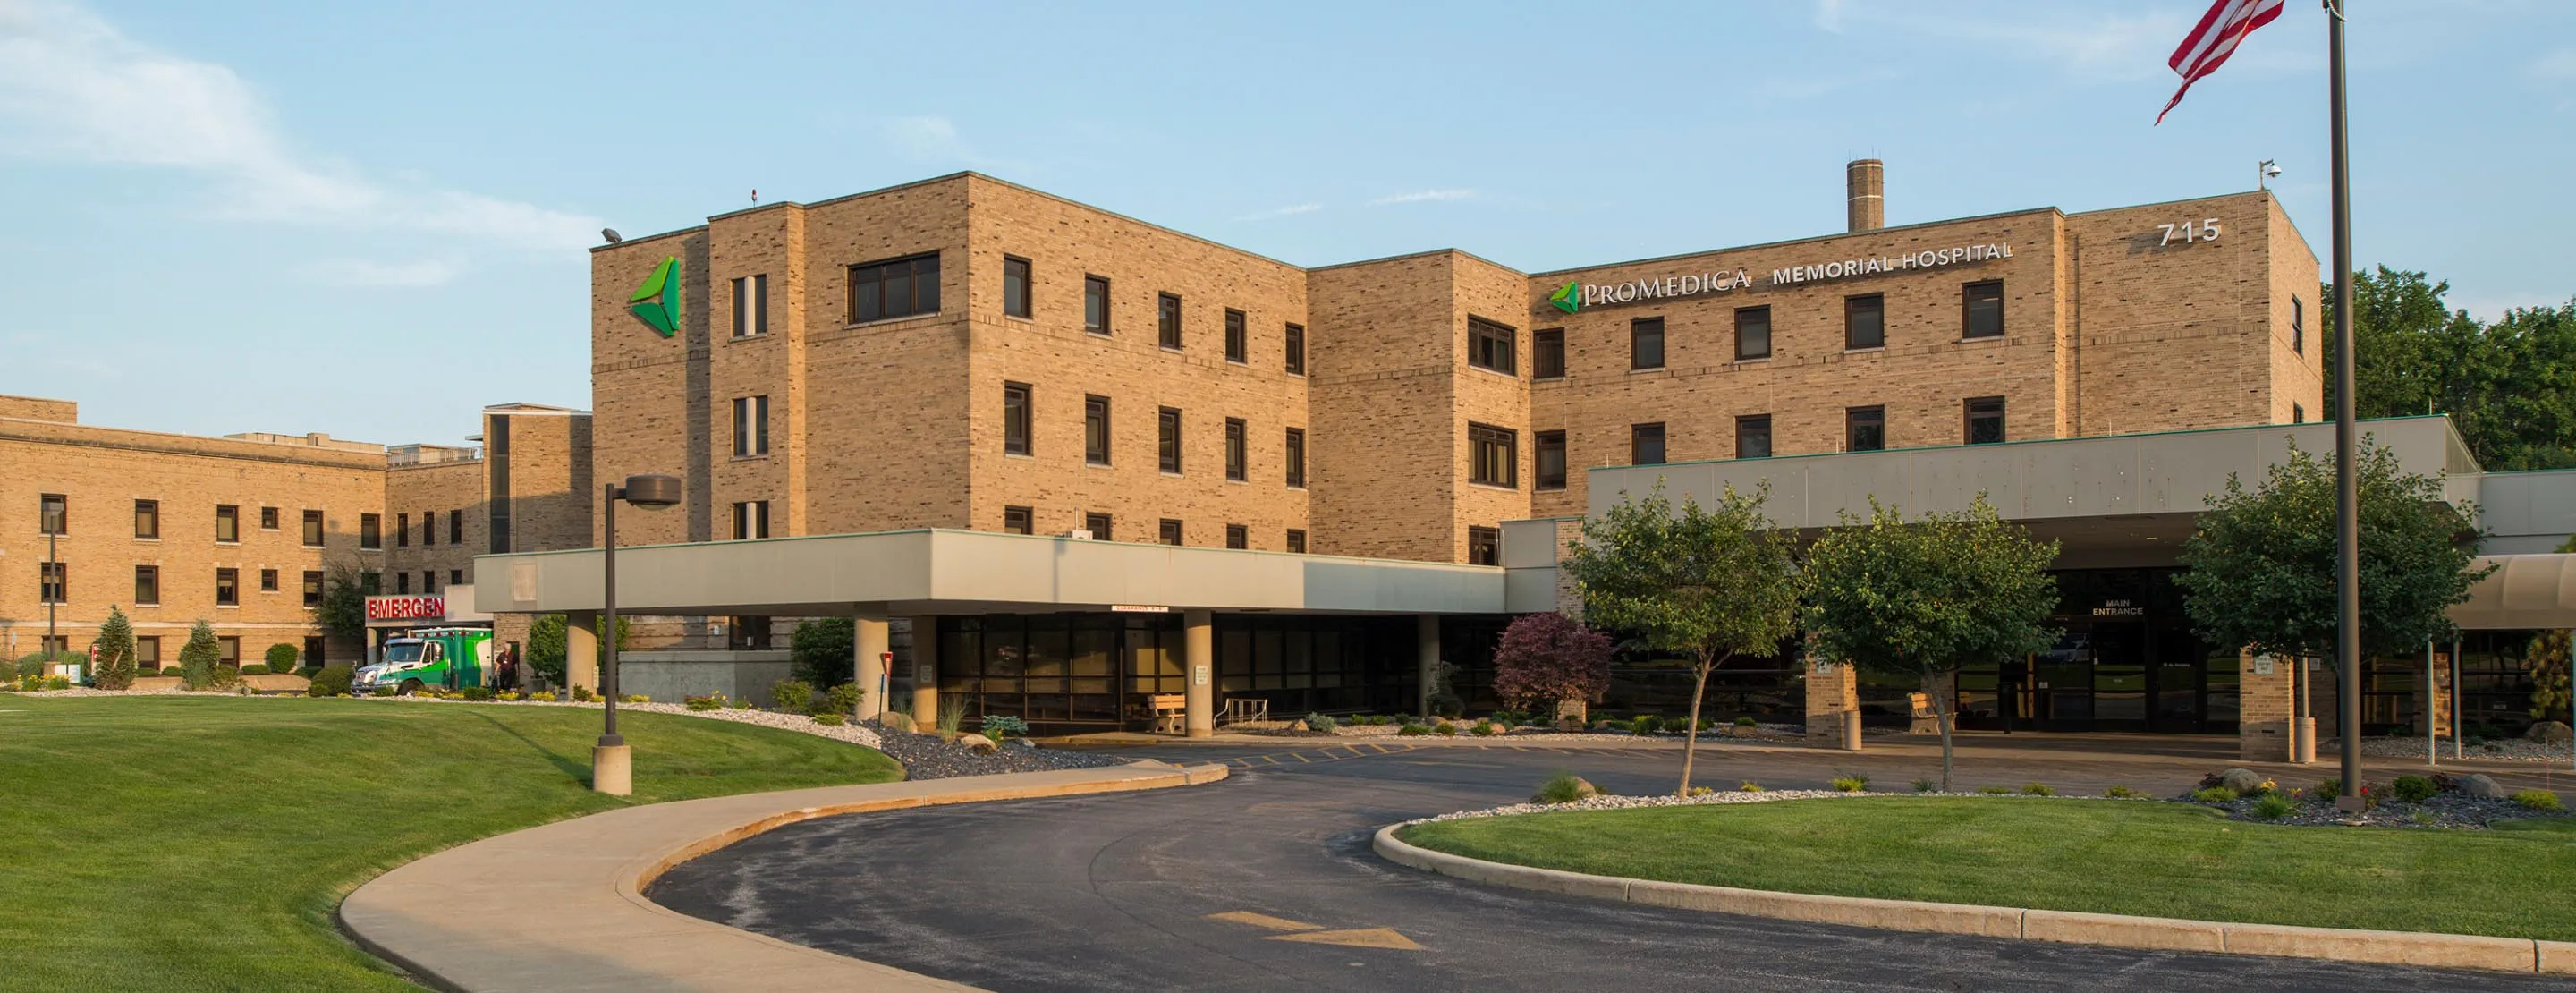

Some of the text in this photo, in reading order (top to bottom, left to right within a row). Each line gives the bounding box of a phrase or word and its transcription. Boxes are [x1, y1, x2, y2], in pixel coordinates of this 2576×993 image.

[2157, 218, 2219, 246] 715
[1584, 242, 2012, 307] PROMEDICA MEMORIAL HOSPITAL
